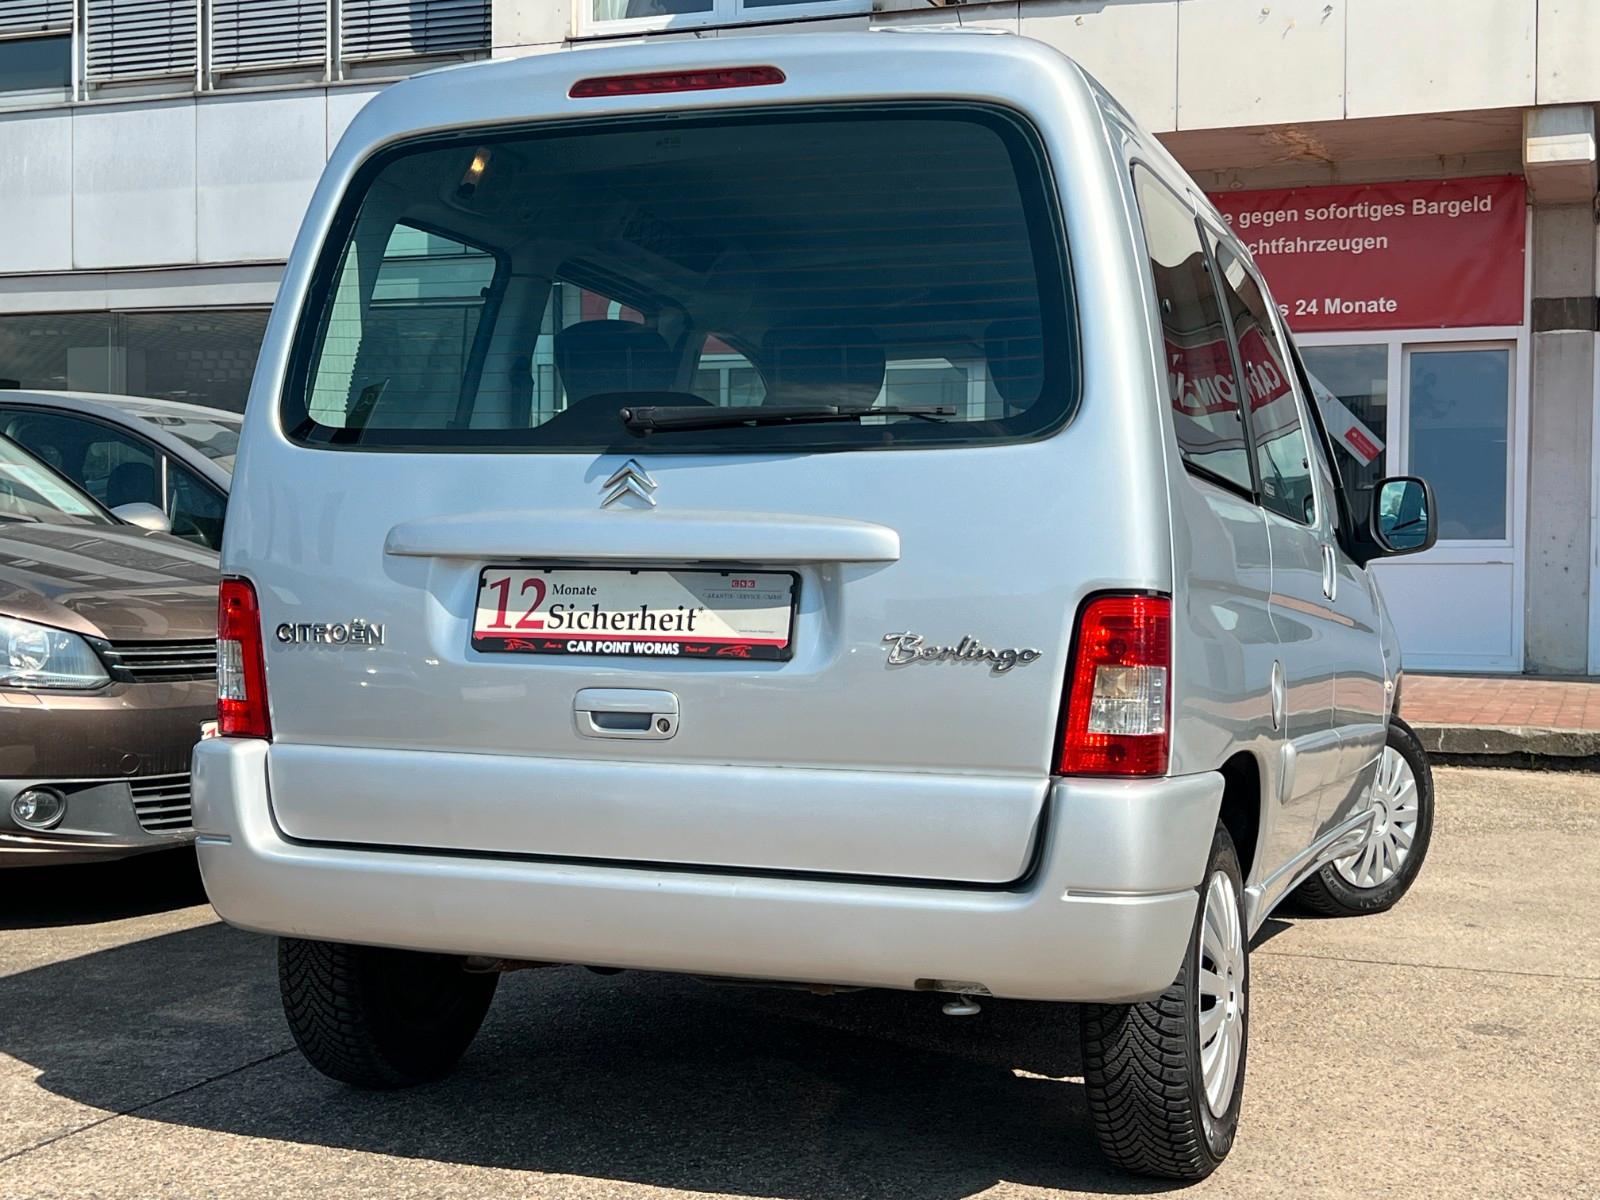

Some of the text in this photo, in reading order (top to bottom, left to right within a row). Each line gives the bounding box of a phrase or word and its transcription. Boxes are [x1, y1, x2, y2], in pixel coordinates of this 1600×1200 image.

[1239, 209, 1298, 228] gegen
[1304, 202, 1405, 221] sofortiges
[1412, 195, 1492, 217] Bargeld
[1247, 236, 1388, 254] chtfahrzeugen
[1295, 299, 1318, 315] 24
[1324, 297, 1397, 314] Monate
[487, 577, 597, 630] 12 Monate
[276, 619, 385, 646] CITROËN
[567, 640, 592, 653] CAR
[595, 641, 631, 654] POINT
[633, 642, 680, 655] WORMS
[882, 631, 1042, 673] Berlingo
